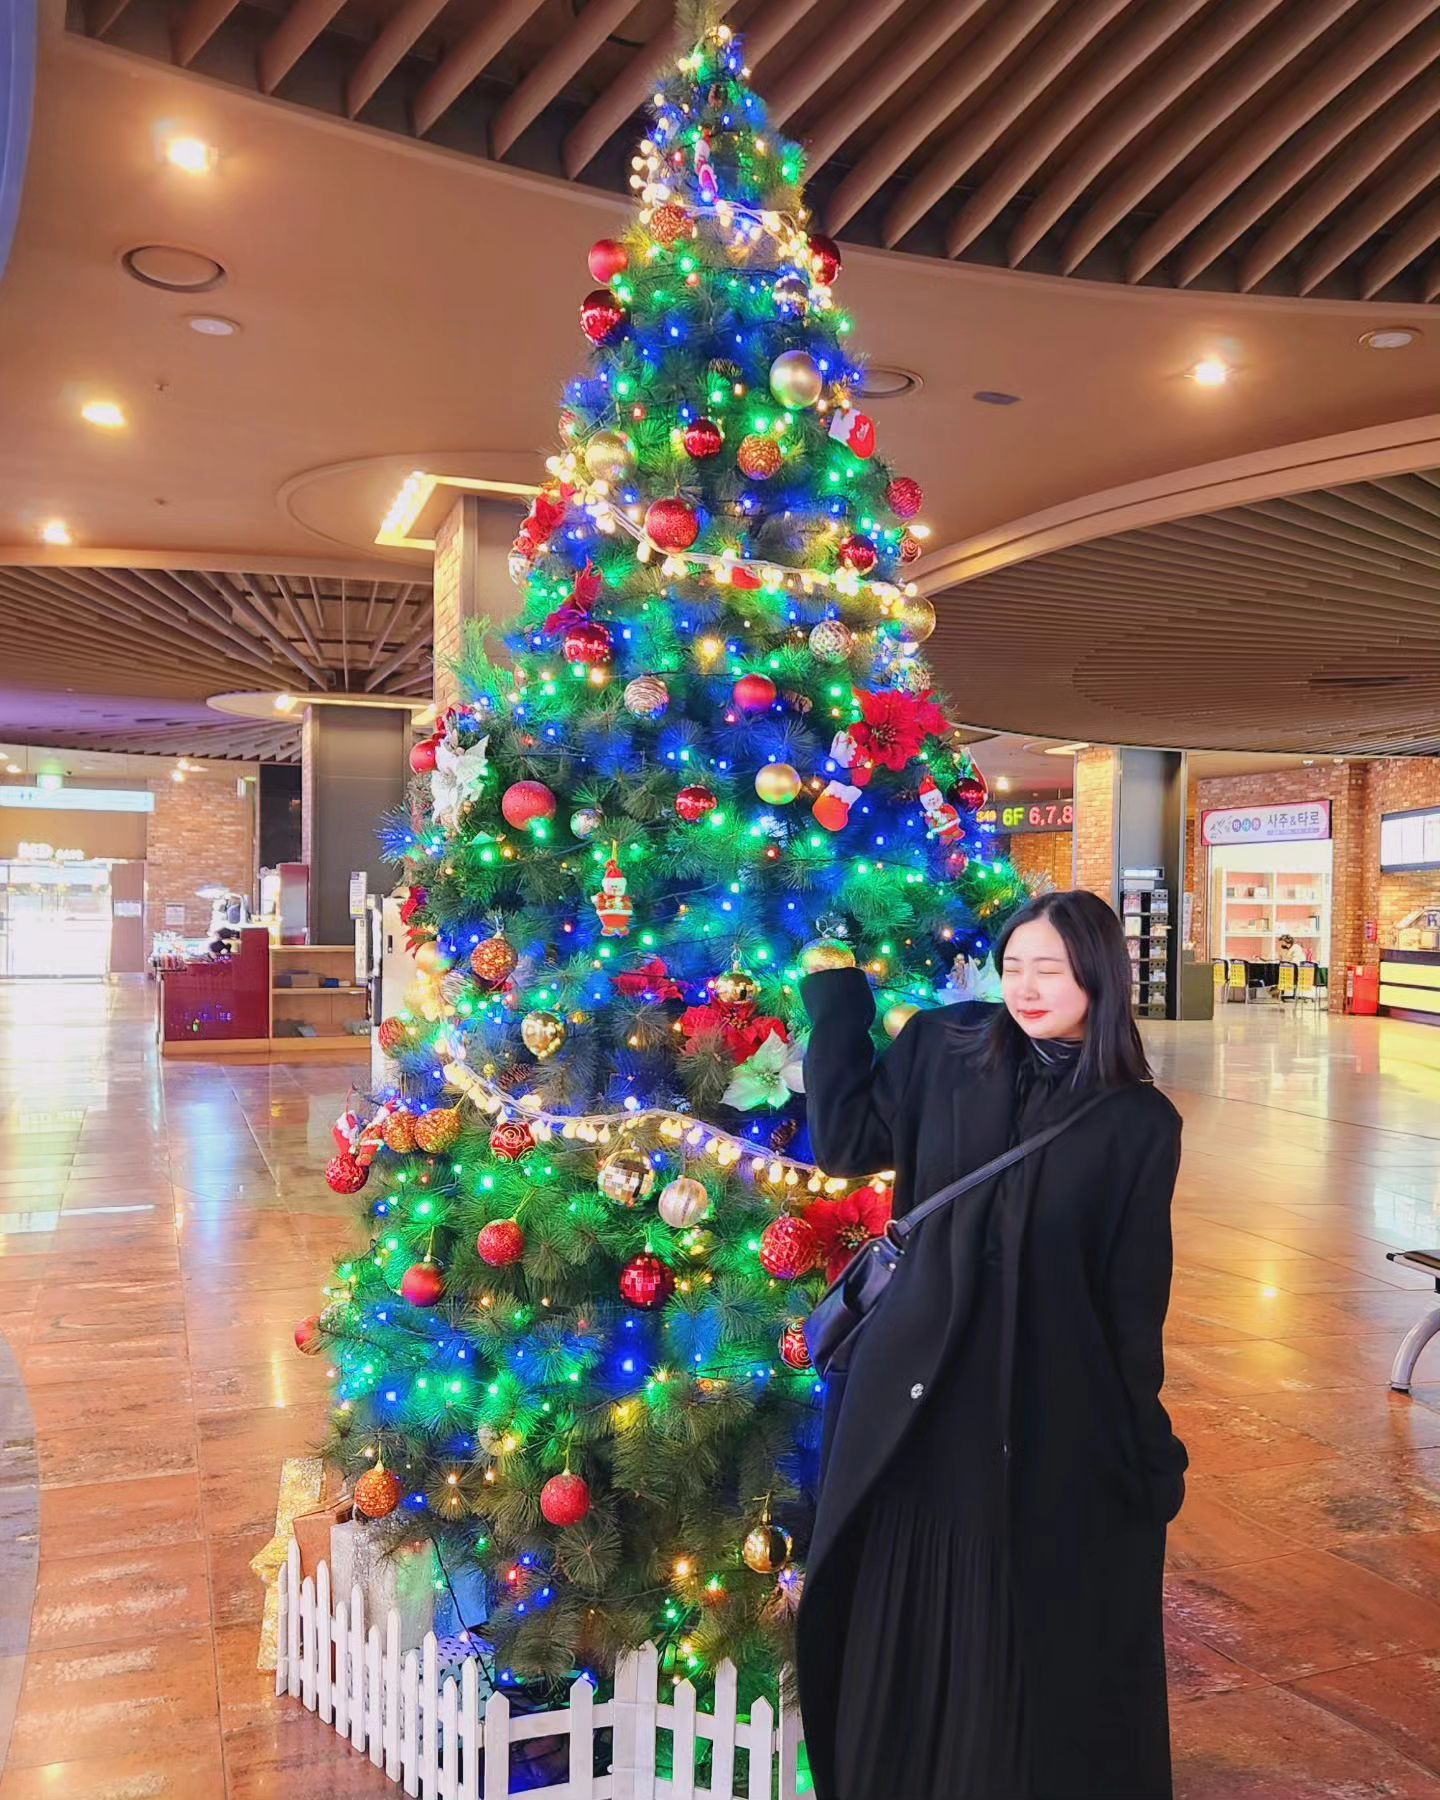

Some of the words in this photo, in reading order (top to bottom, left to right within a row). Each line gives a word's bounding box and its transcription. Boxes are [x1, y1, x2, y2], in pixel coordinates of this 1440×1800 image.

[1003, 807, 1025, 826] 6F
[1029, 805, 1073, 826] 6,7,8
[1268, 811, 1320, 829] 사주&타로
